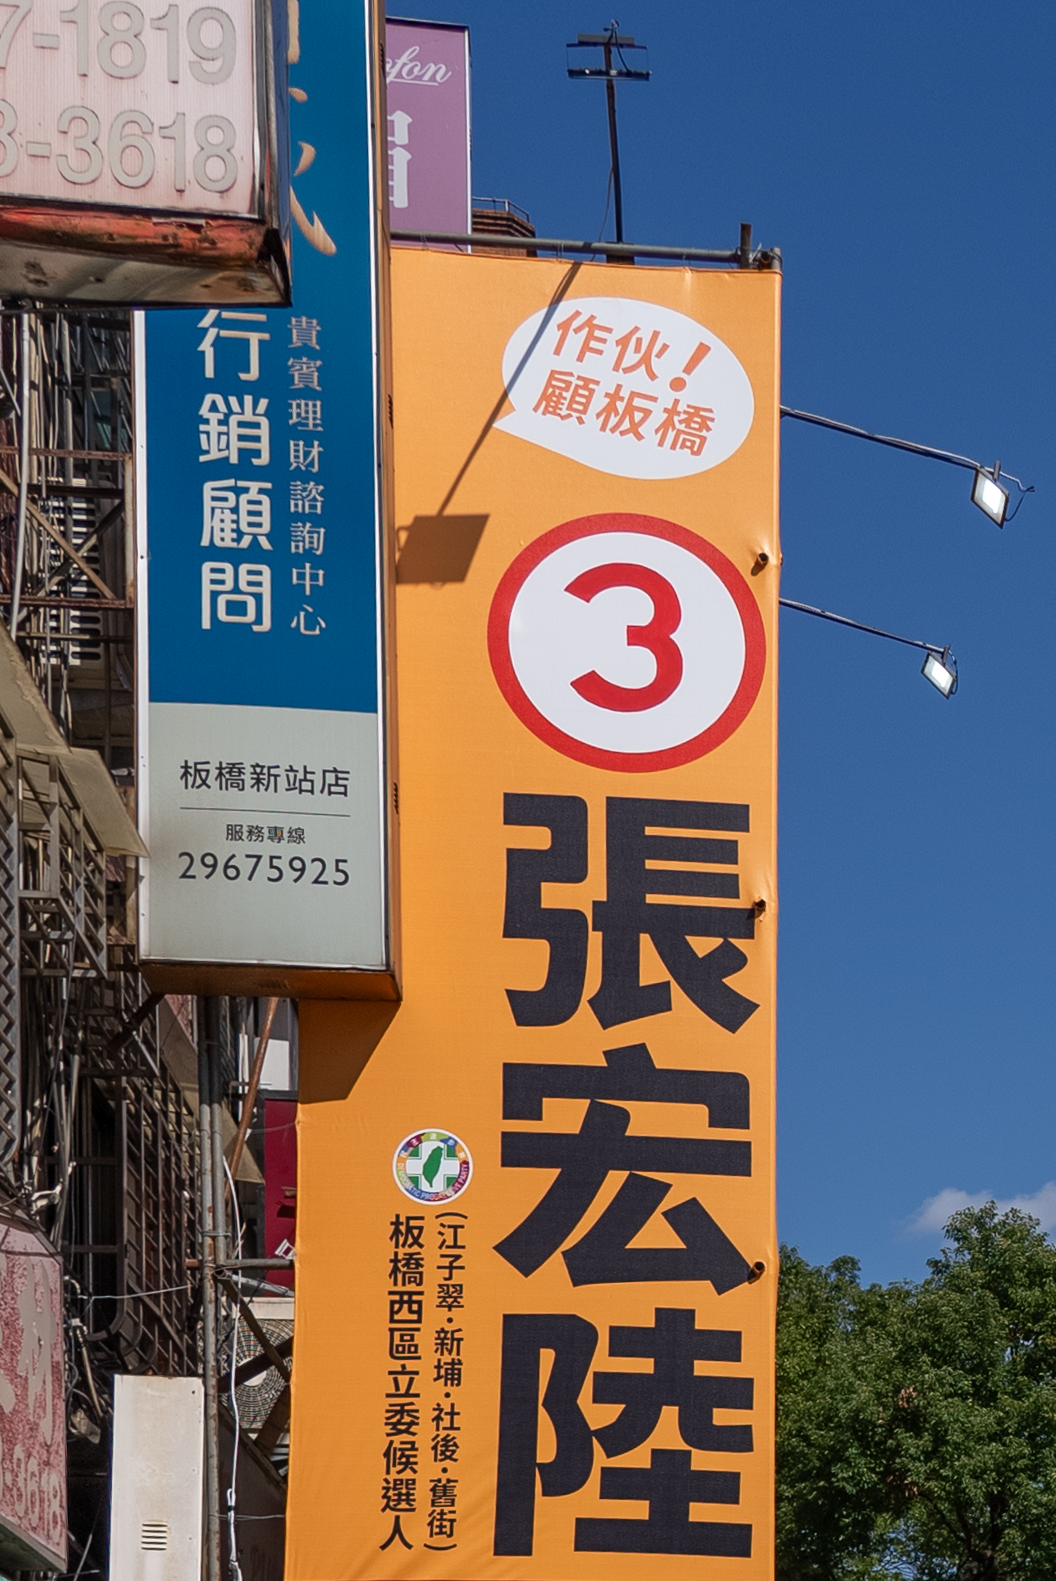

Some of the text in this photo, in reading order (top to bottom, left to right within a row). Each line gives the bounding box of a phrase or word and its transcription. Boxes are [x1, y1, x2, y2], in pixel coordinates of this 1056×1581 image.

[197, 308, 273, 633] 行銷顧問
[287, 315, 327, 637] 貴賓理財諮詢中心
[533, 369, 716, 457] 顧板橋
[564, 562, 684, 713] 3
[179, 759, 351, 798] 板橋新站店
[225, 823, 306, 845] 服務專線
[178, 851, 350, 887] 29675925
[491, 791, 761, 1559] 張宏陸
[379, 1213, 425, 1552] 板橋西區立委候選人
